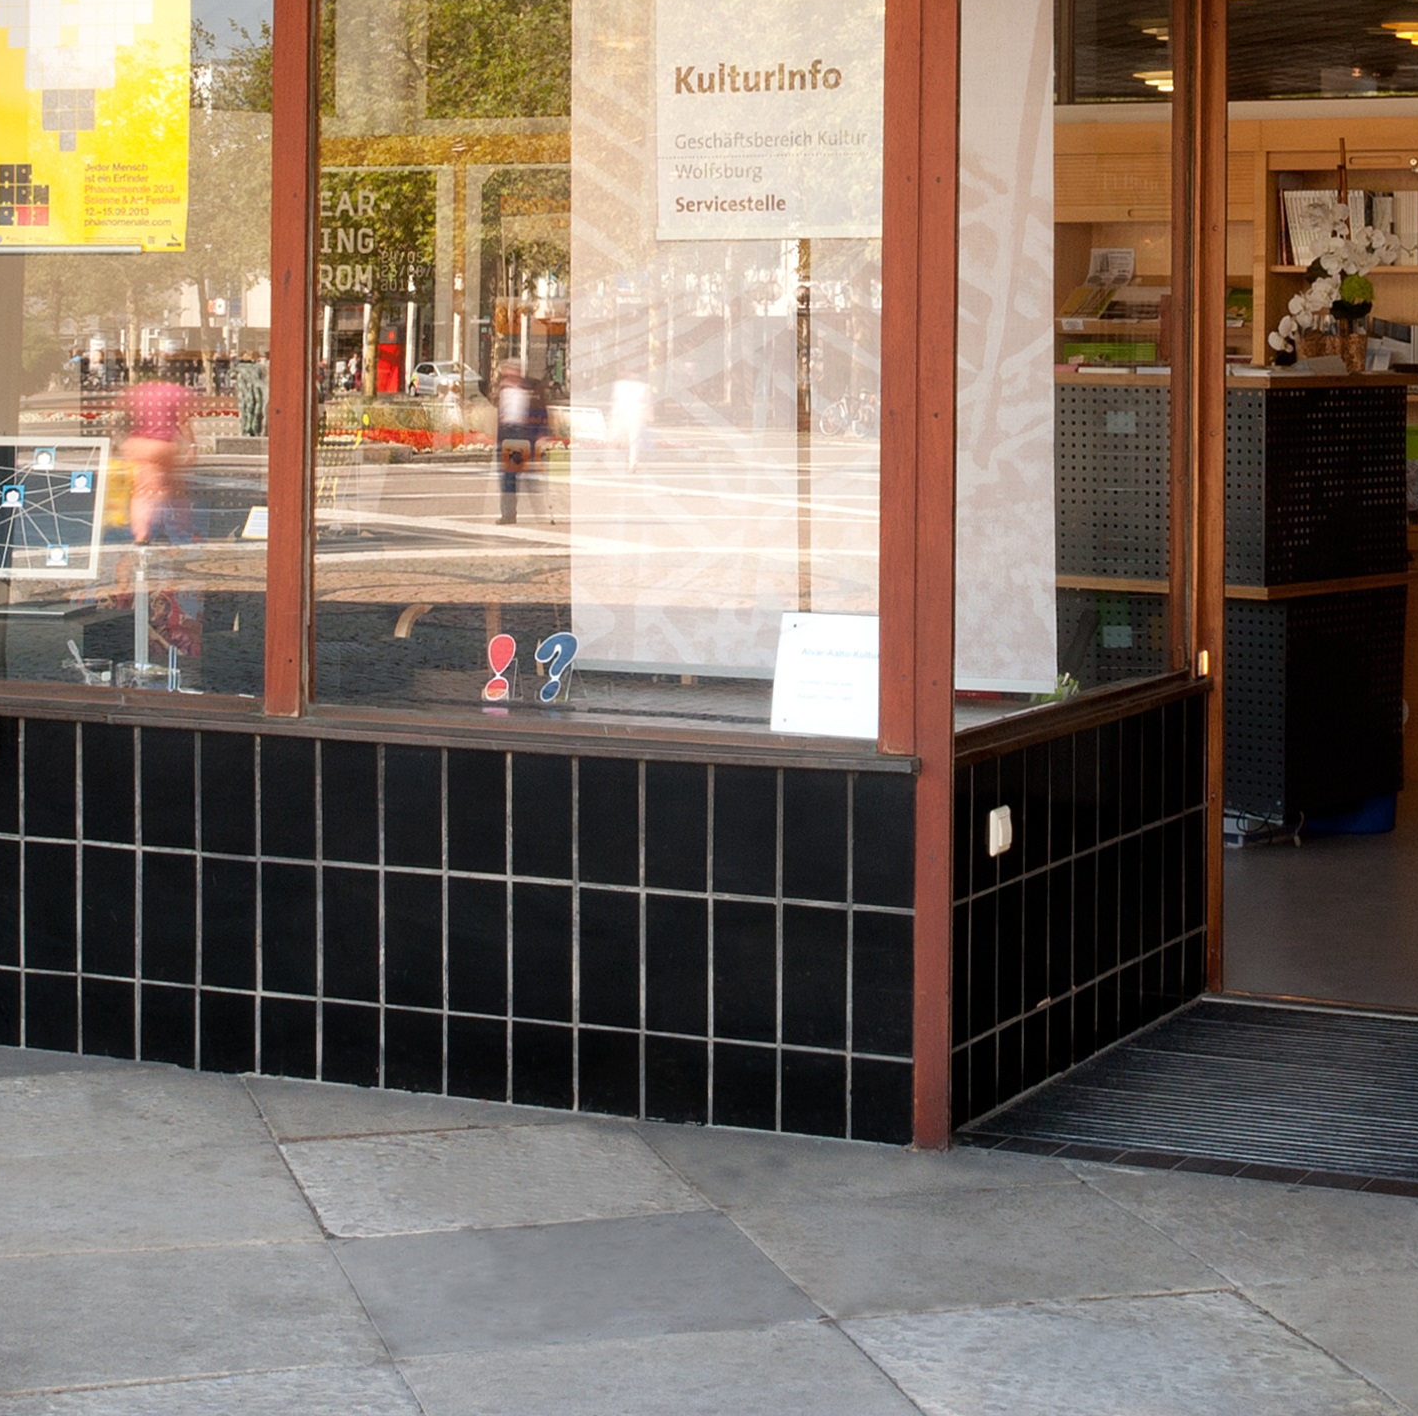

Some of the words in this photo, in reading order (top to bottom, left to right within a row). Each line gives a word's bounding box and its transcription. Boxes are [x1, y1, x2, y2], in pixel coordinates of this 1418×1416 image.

[674, 59, 843, 95] KulturInfo
[674, 130, 813, 150] Geschäftsbereich
[817, 129, 868, 147] Kultur
[112, 163, 148, 173] Mensch
[674, 162, 763, 184] Wolfsburg
[84, 174, 96, 183] ist
[97, 174, 111, 183] ein
[113, 174, 149, 183] Erfinder
[153, 185, 174, 195] 2013
[144, 196, 181, 205] Festival
[675, 194, 787, 213] Servicestelle
[84, 218, 172, 228] phaenomenale.com
